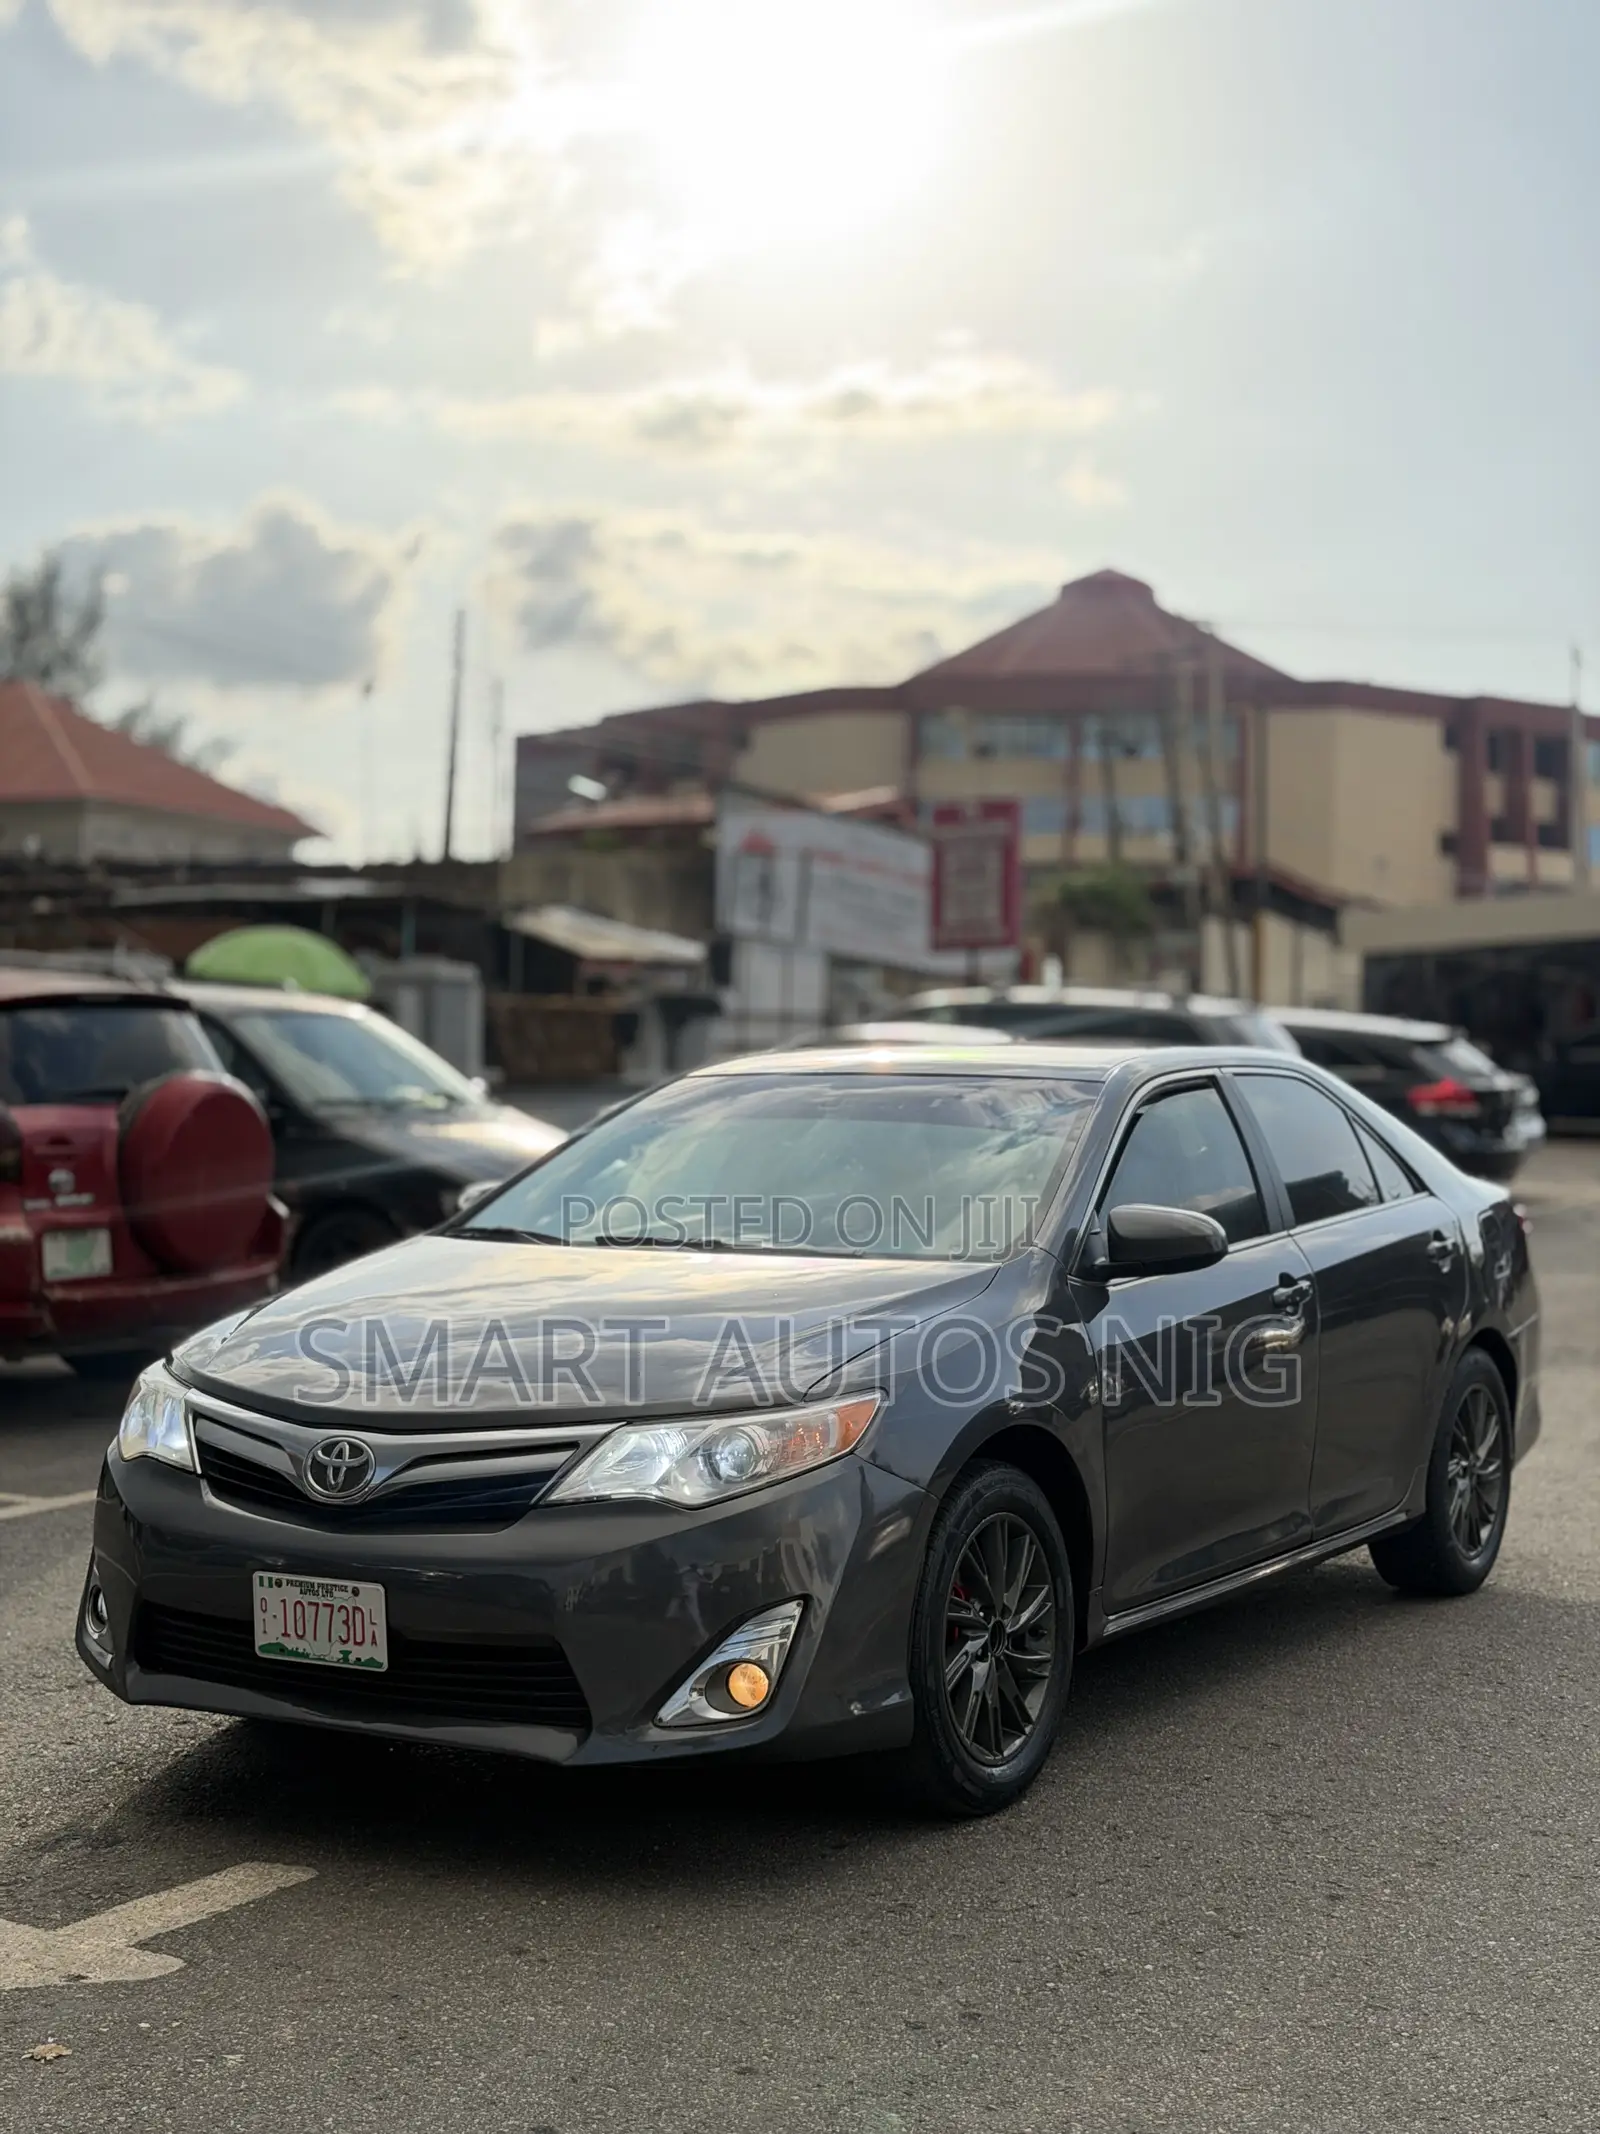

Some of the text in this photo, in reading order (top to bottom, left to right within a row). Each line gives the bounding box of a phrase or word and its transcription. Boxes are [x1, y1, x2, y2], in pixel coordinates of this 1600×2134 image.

[286, 1579, 349, 1593] PREMIUM PRESTIGE
[299, 1588, 334, 1598] AUTOS LTD
[280, 1598, 366, 1647] 10773D
